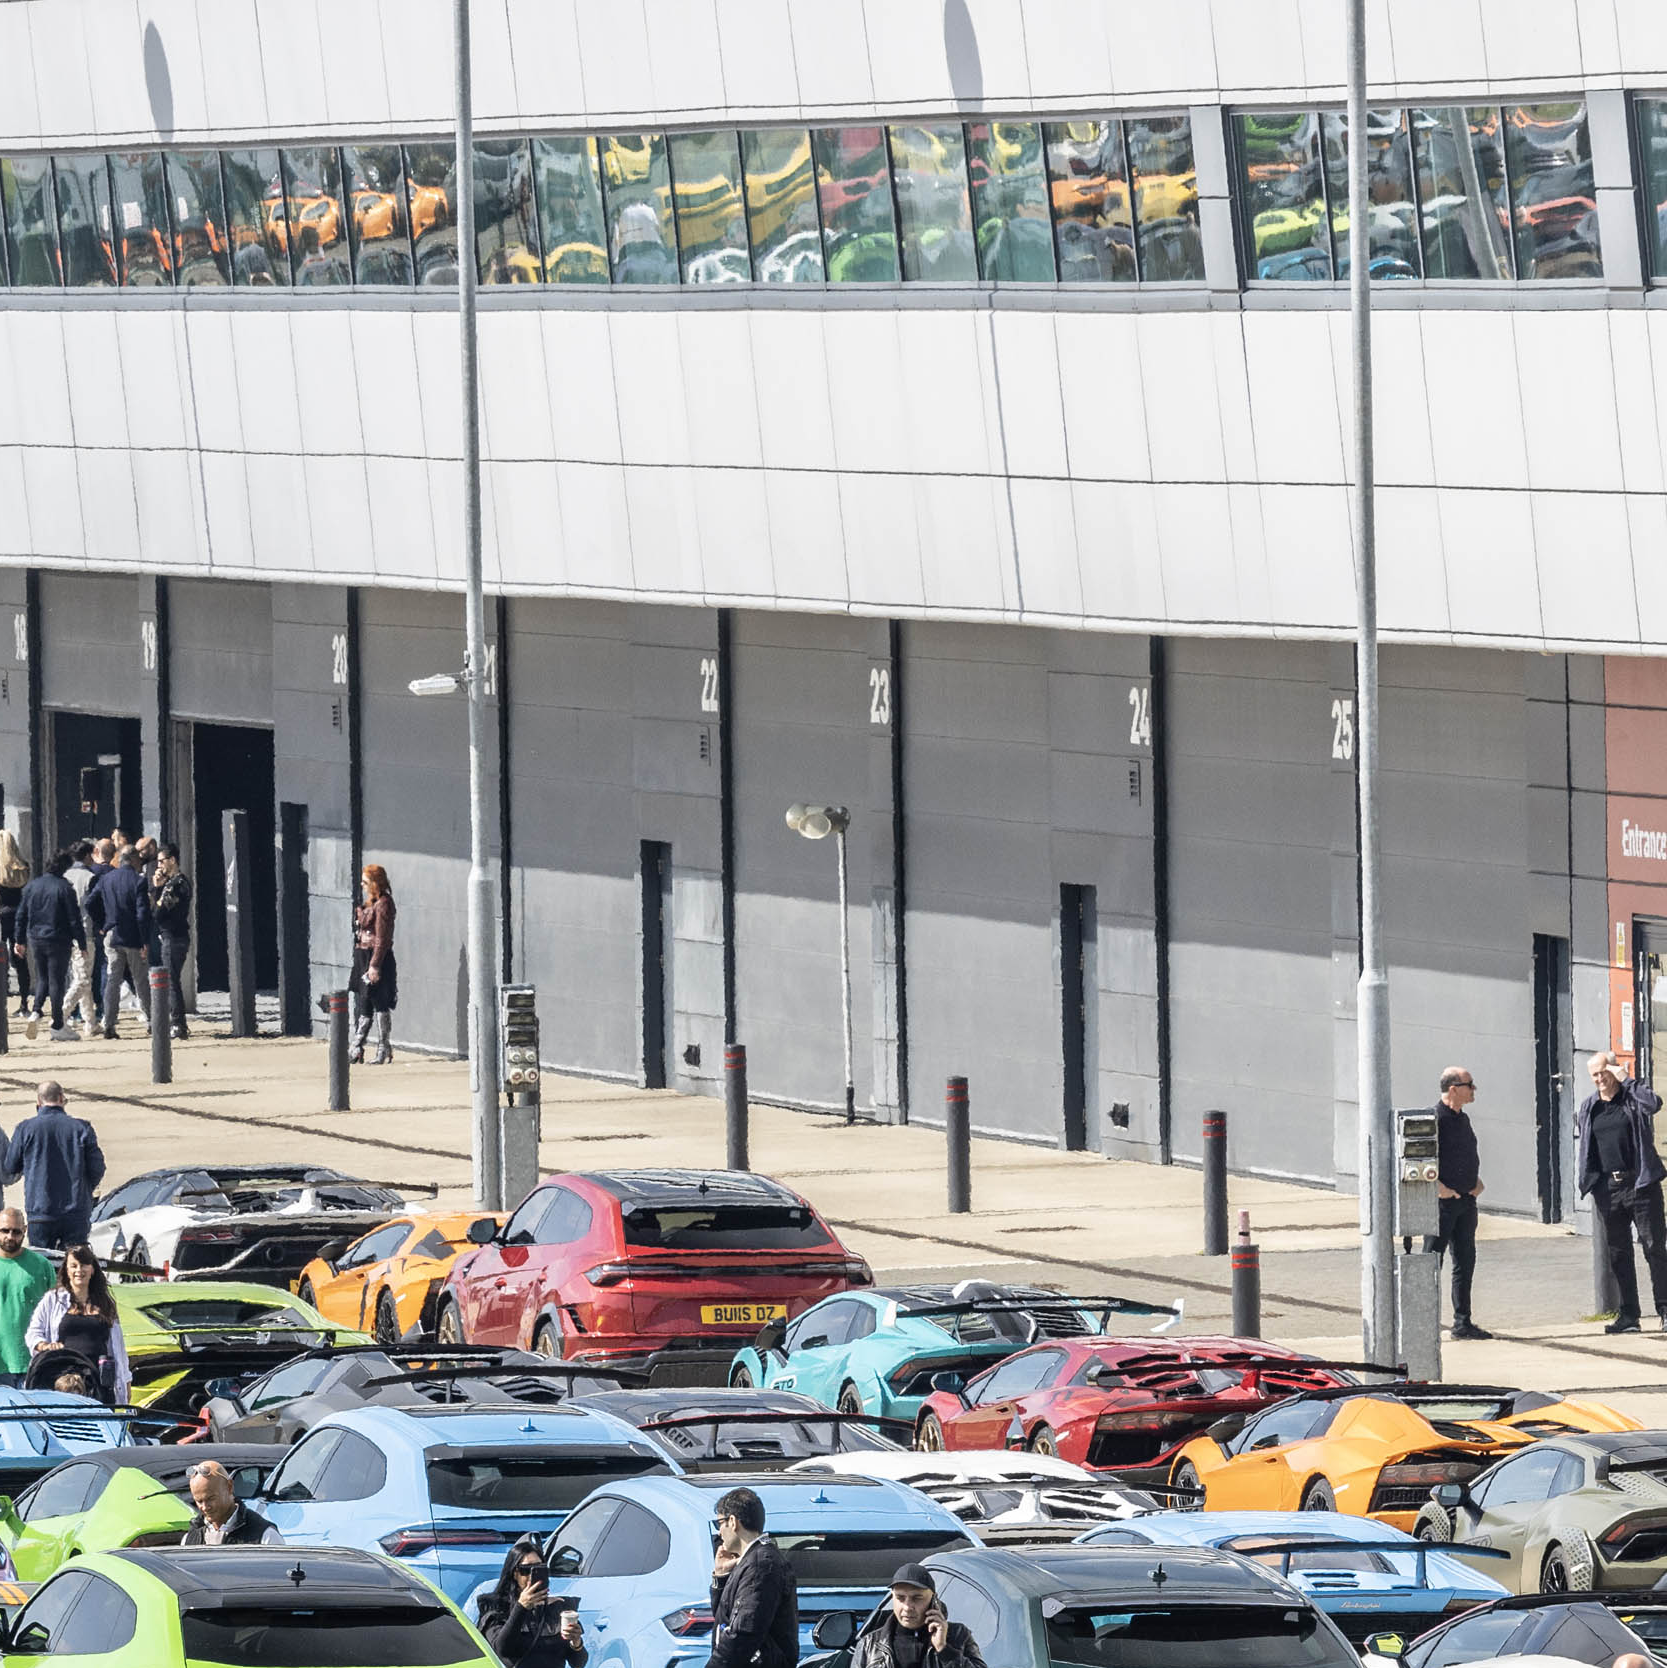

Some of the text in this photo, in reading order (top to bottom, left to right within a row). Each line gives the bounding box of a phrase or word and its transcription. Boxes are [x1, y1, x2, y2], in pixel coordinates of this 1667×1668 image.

[142, 621, 157, 670] 19
[333, 635, 347, 684] 20
[700, 658, 718, 712] 22
[870, 668, 890, 724] 23
[1129, 687, 1151, 746] 24
[1331, 699, 1353, 760] 25
[1622, 818, 1667, 861] Entrance
